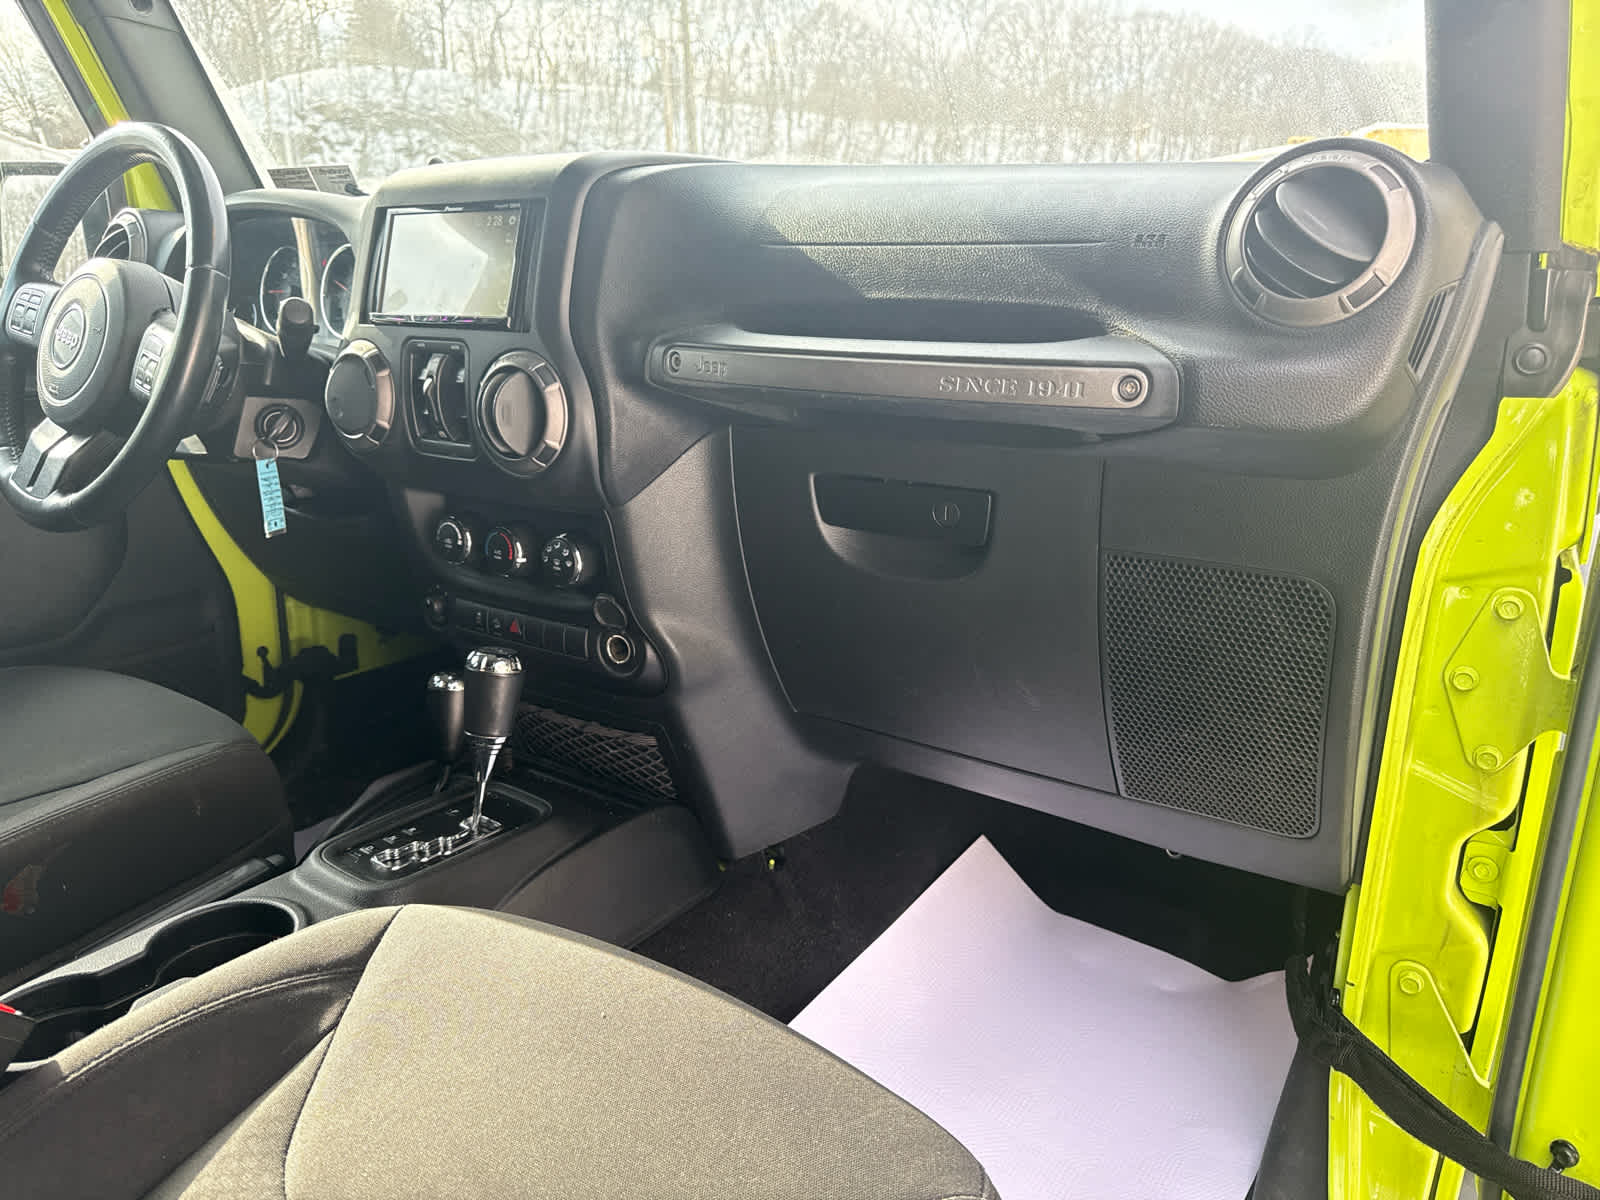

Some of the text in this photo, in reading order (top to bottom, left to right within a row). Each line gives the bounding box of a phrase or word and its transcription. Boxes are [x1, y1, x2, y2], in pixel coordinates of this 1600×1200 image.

[695, 353, 728, 377] Jeep
[938, 375, 1086, 399] SINCE 1941
